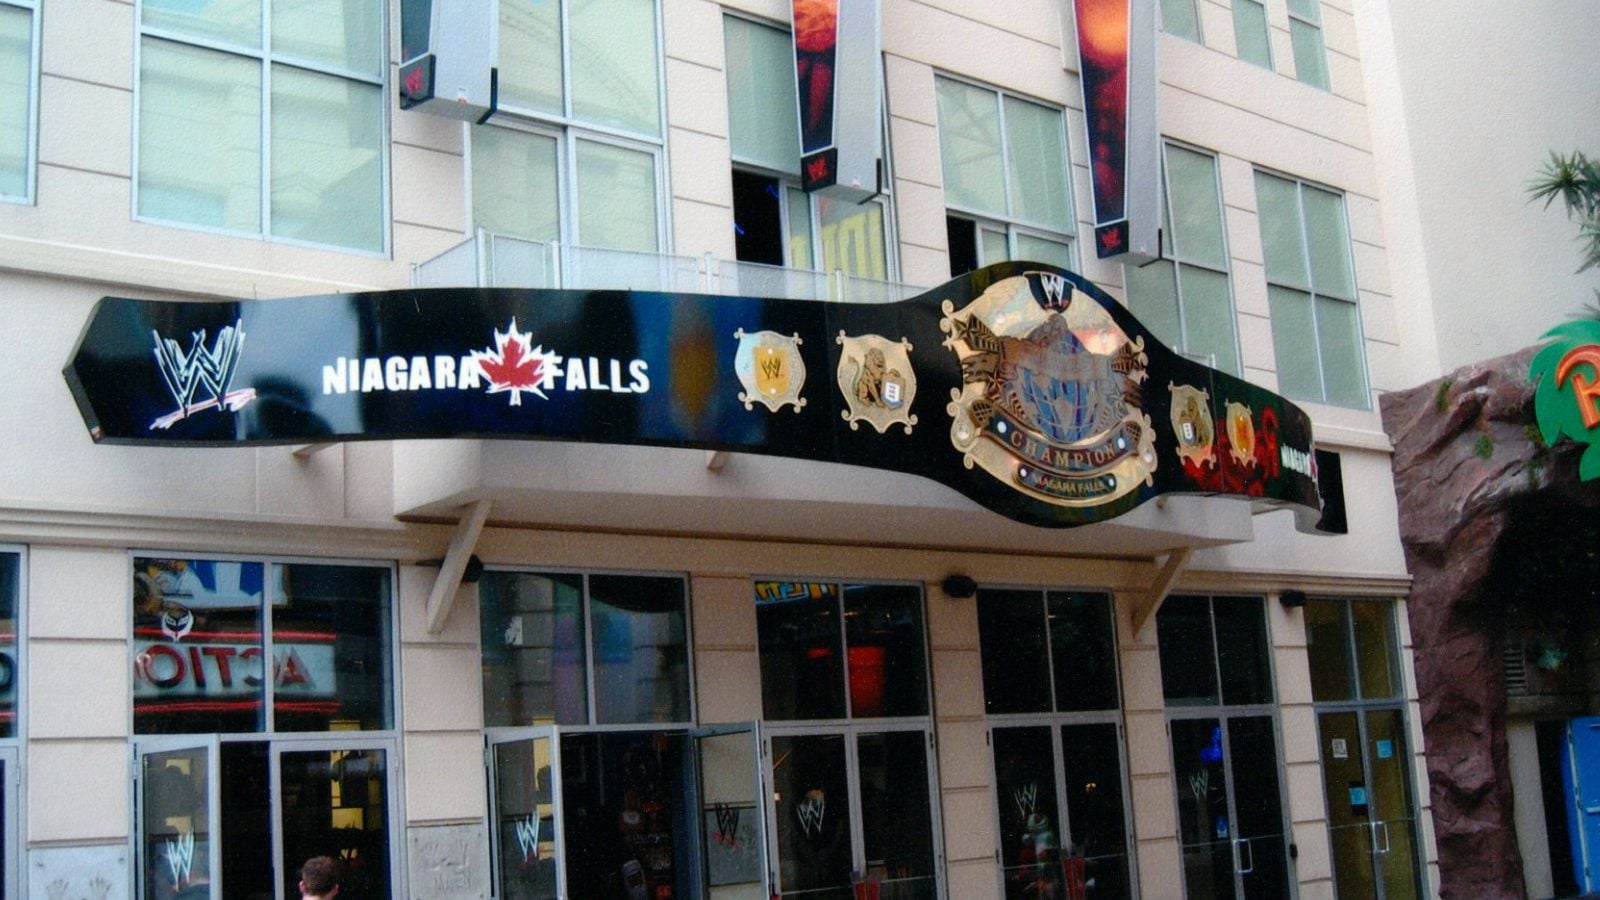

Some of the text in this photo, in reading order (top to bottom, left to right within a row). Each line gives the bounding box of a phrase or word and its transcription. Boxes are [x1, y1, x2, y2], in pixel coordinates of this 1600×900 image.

[322, 350, 650, 395] NIAGARA FALLS
[1011, 431, 1116, 468] CHAMPION
